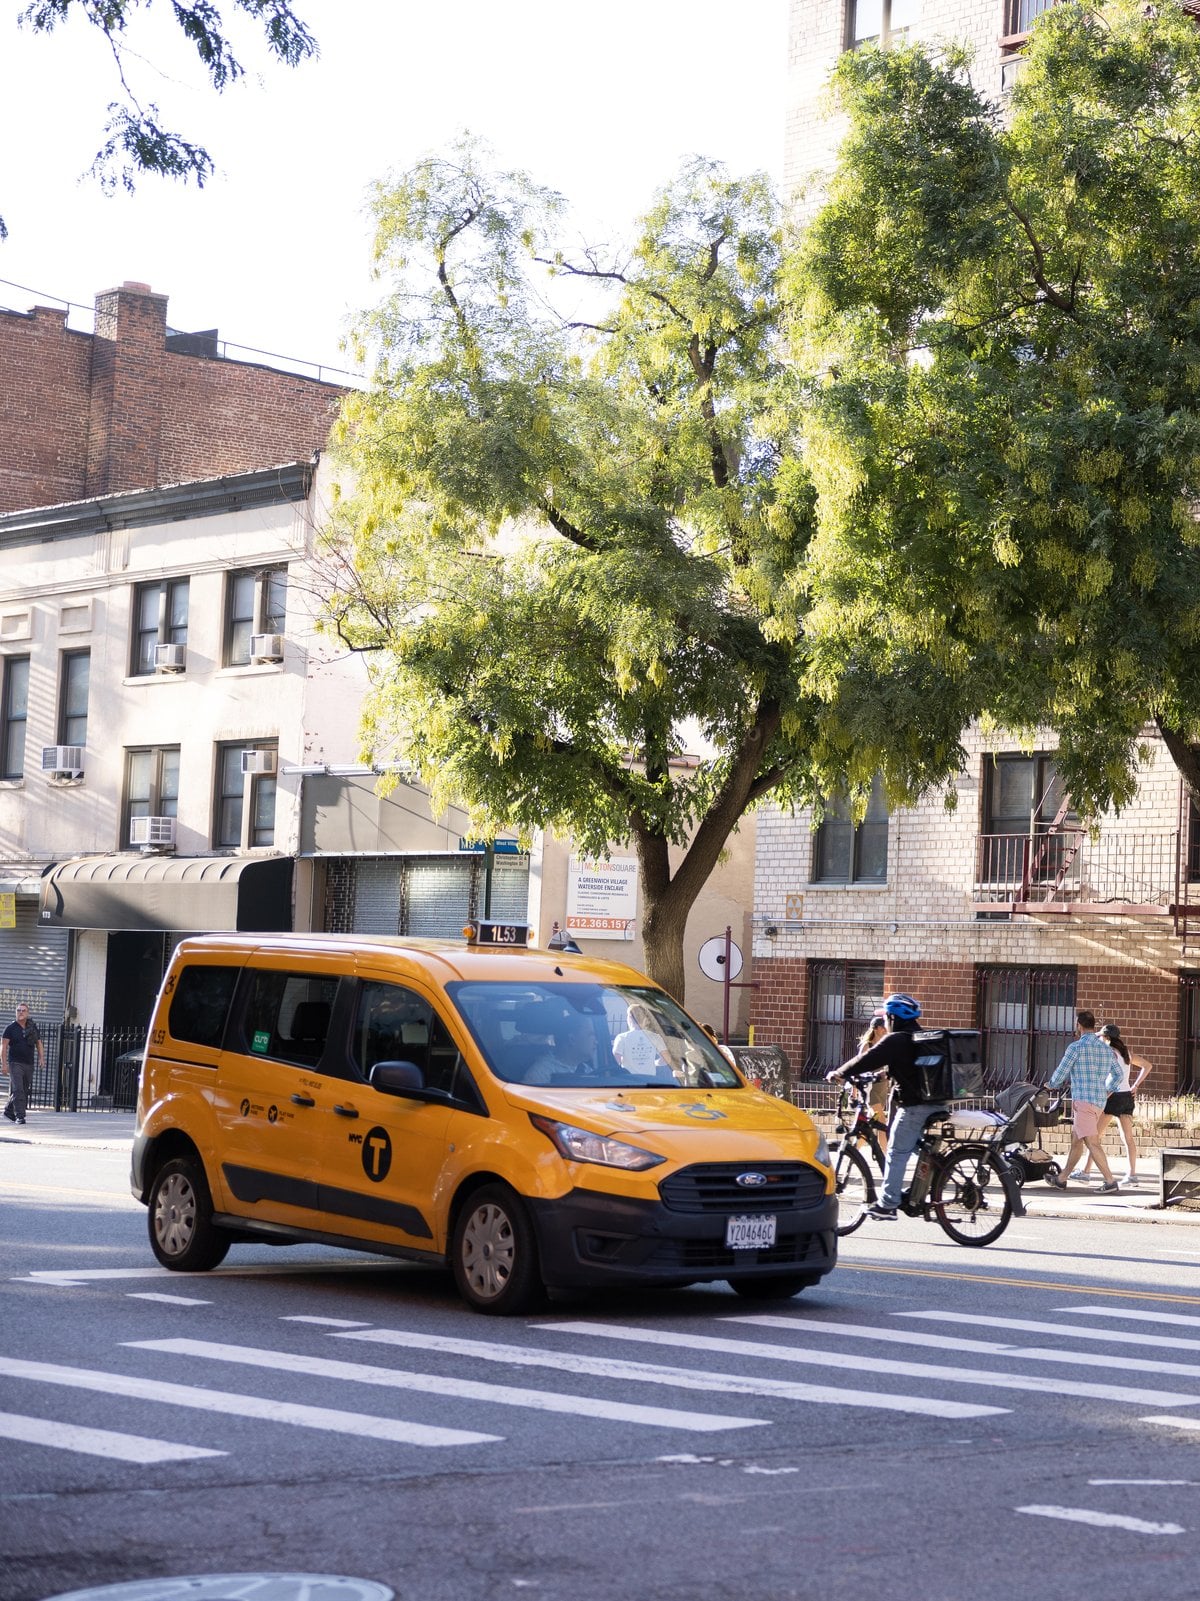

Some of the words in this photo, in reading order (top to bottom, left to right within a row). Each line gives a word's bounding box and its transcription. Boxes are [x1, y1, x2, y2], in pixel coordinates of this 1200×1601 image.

[584, 862, 636, 873] MTONSQUARE
[491, 925, 516, 942] 1L53
[348, 1132, 363, 1144] NYC
[369, 1137, 386, 1175] T
[744, 1175, 762, 1184] Ford
[730, 1223, 773, 1241] Y204646C
